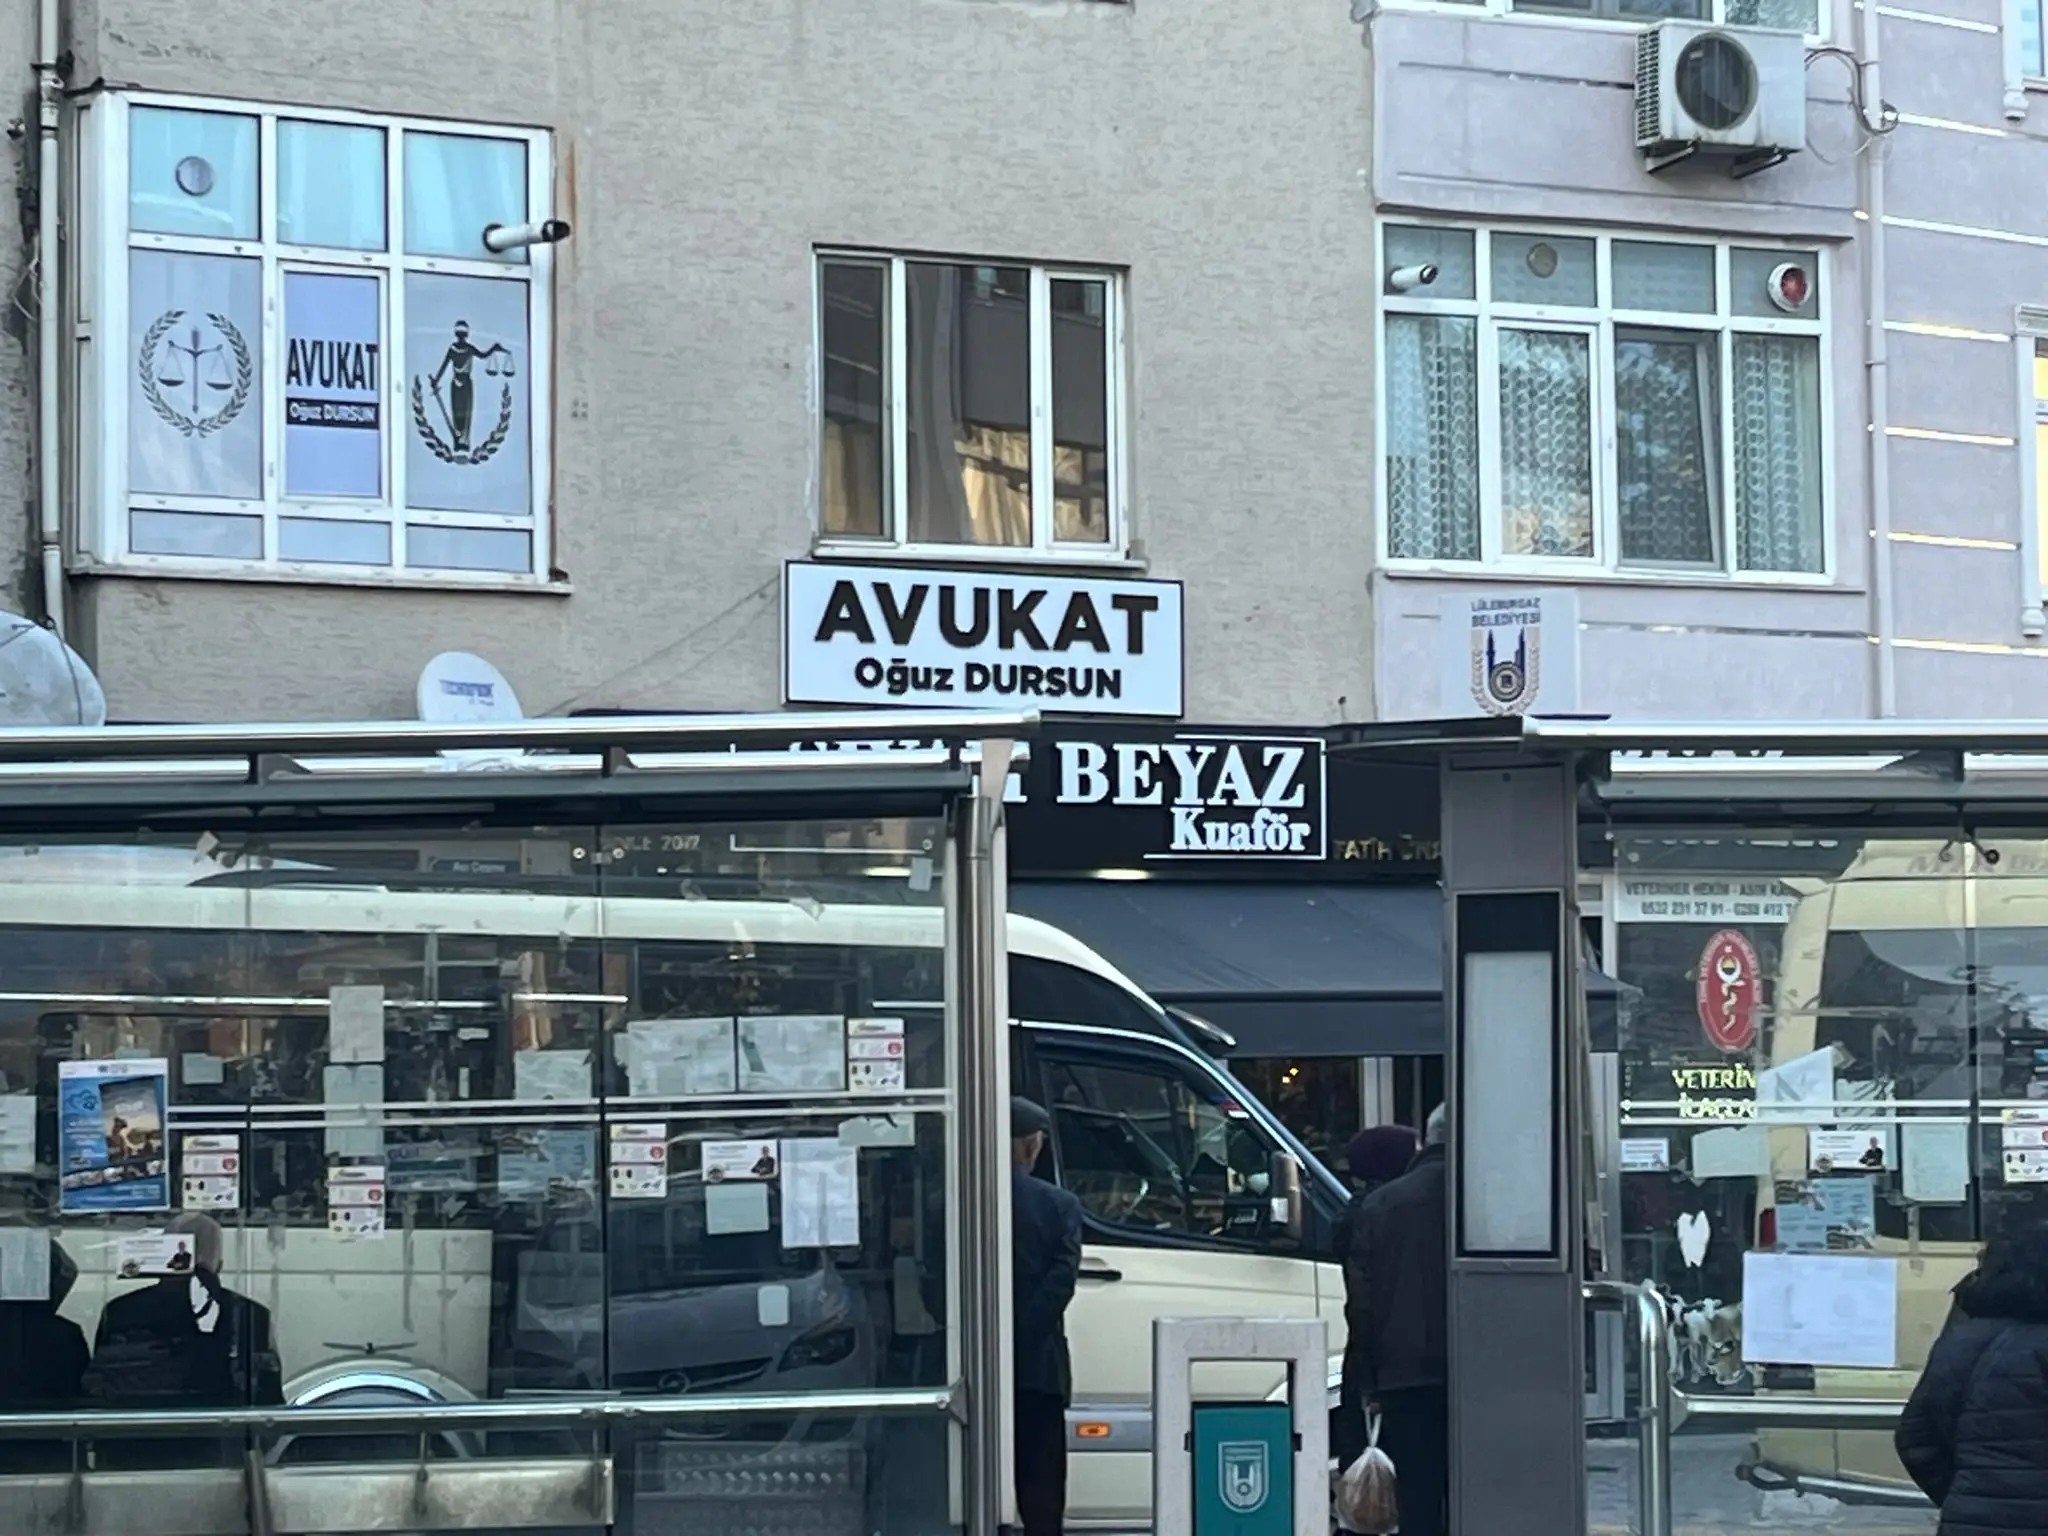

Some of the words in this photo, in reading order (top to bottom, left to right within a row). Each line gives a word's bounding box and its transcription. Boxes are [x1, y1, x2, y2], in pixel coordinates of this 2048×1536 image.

[286, 338, 378, 390] AVUKAT
[289, 401, 322, 422] Oğuz
[323, 403, 376, 423] DURSUN
[814, 579, 1159, 656] AVUKAT
[854, 656, 954, 696] Oğuz
[963, 661, 1121, 699] DURSUN
[1055, 741, 1305, 808] BEYAZ
[1169, 805, 1311, 852] Kuaför
